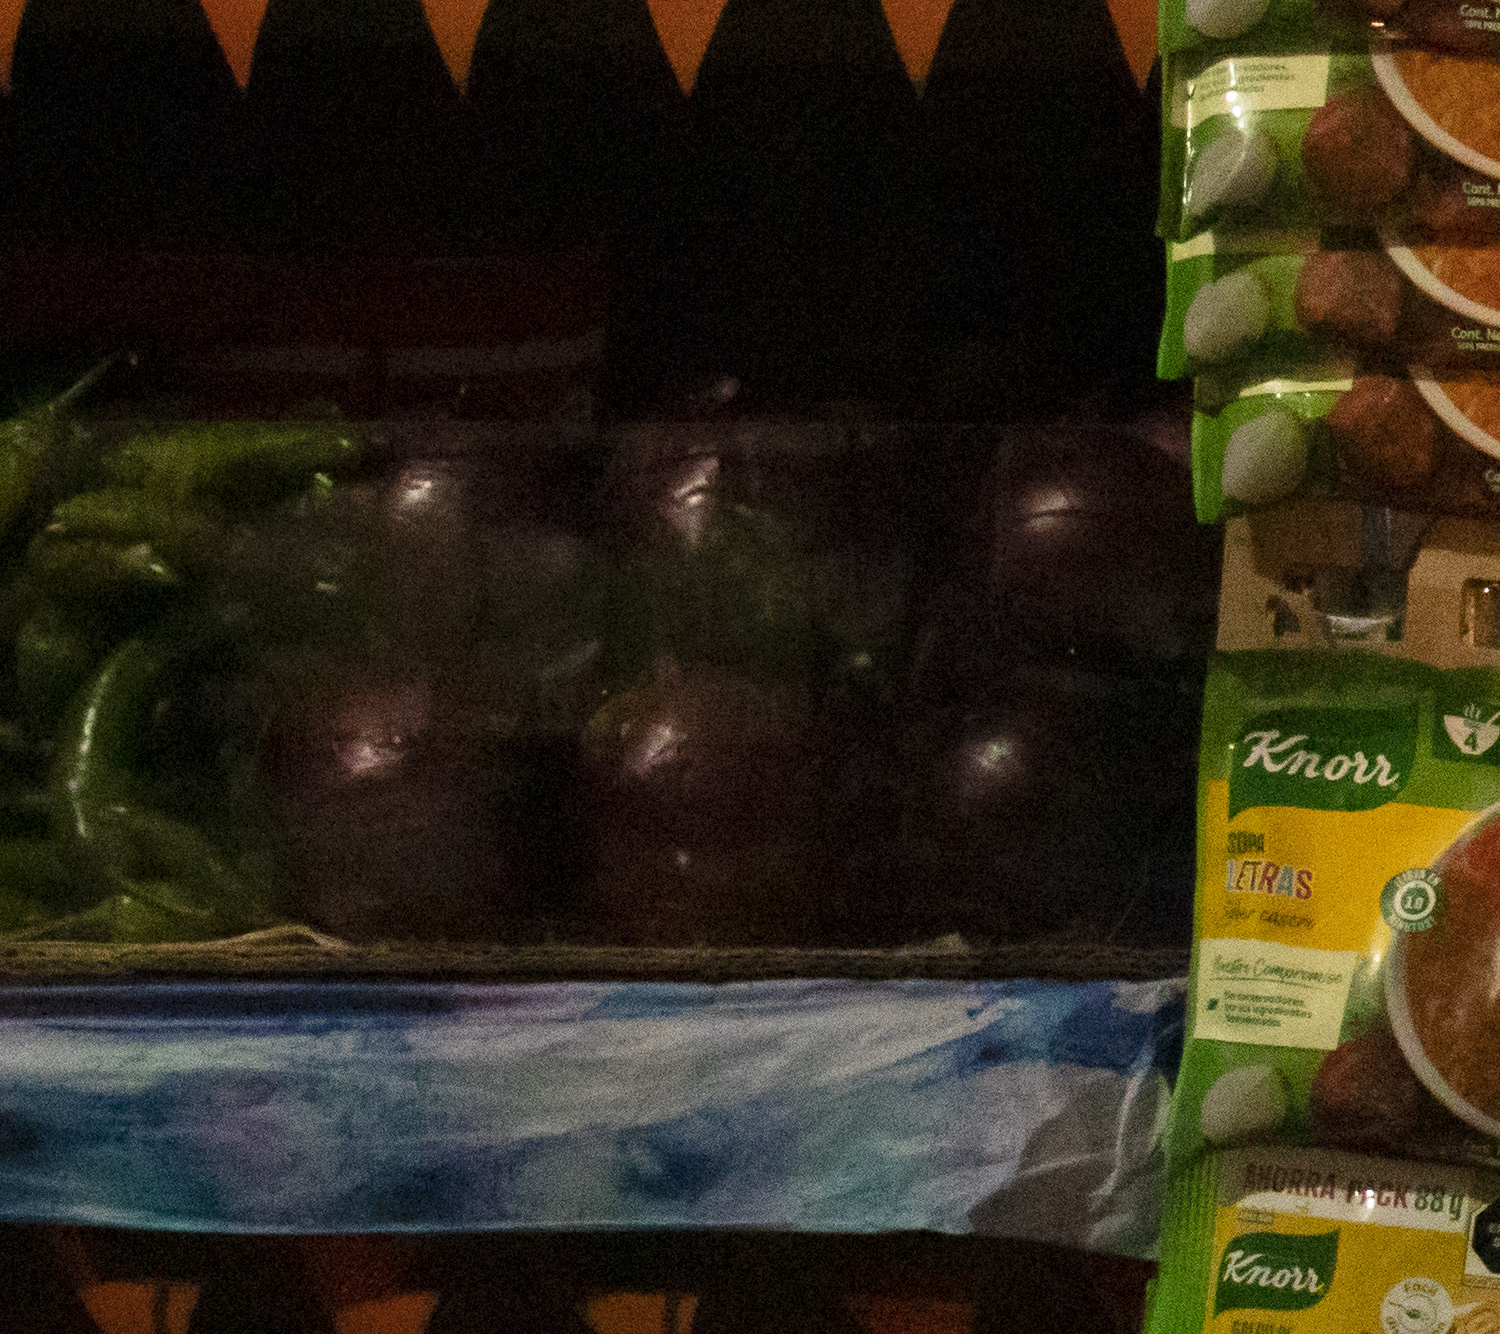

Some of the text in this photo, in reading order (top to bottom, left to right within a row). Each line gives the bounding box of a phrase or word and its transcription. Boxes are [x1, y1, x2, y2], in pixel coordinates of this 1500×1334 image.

[1242, 730, 1399, 787] Knorr
[1464, 732, 1478, 750] 4
[1227, 832, 1265, 854] SOPA
[1225, 859, 1313, 900] LETRAS
[1404, 895, 1425, 910] 10
[1243, 1163, 1335, 1201] AHORRA
[1413, 1186, 1445, 1215] 88
[1447, 1191, 1464, 1222] g
[1223, 1248, 1325, 1294] Knorr
